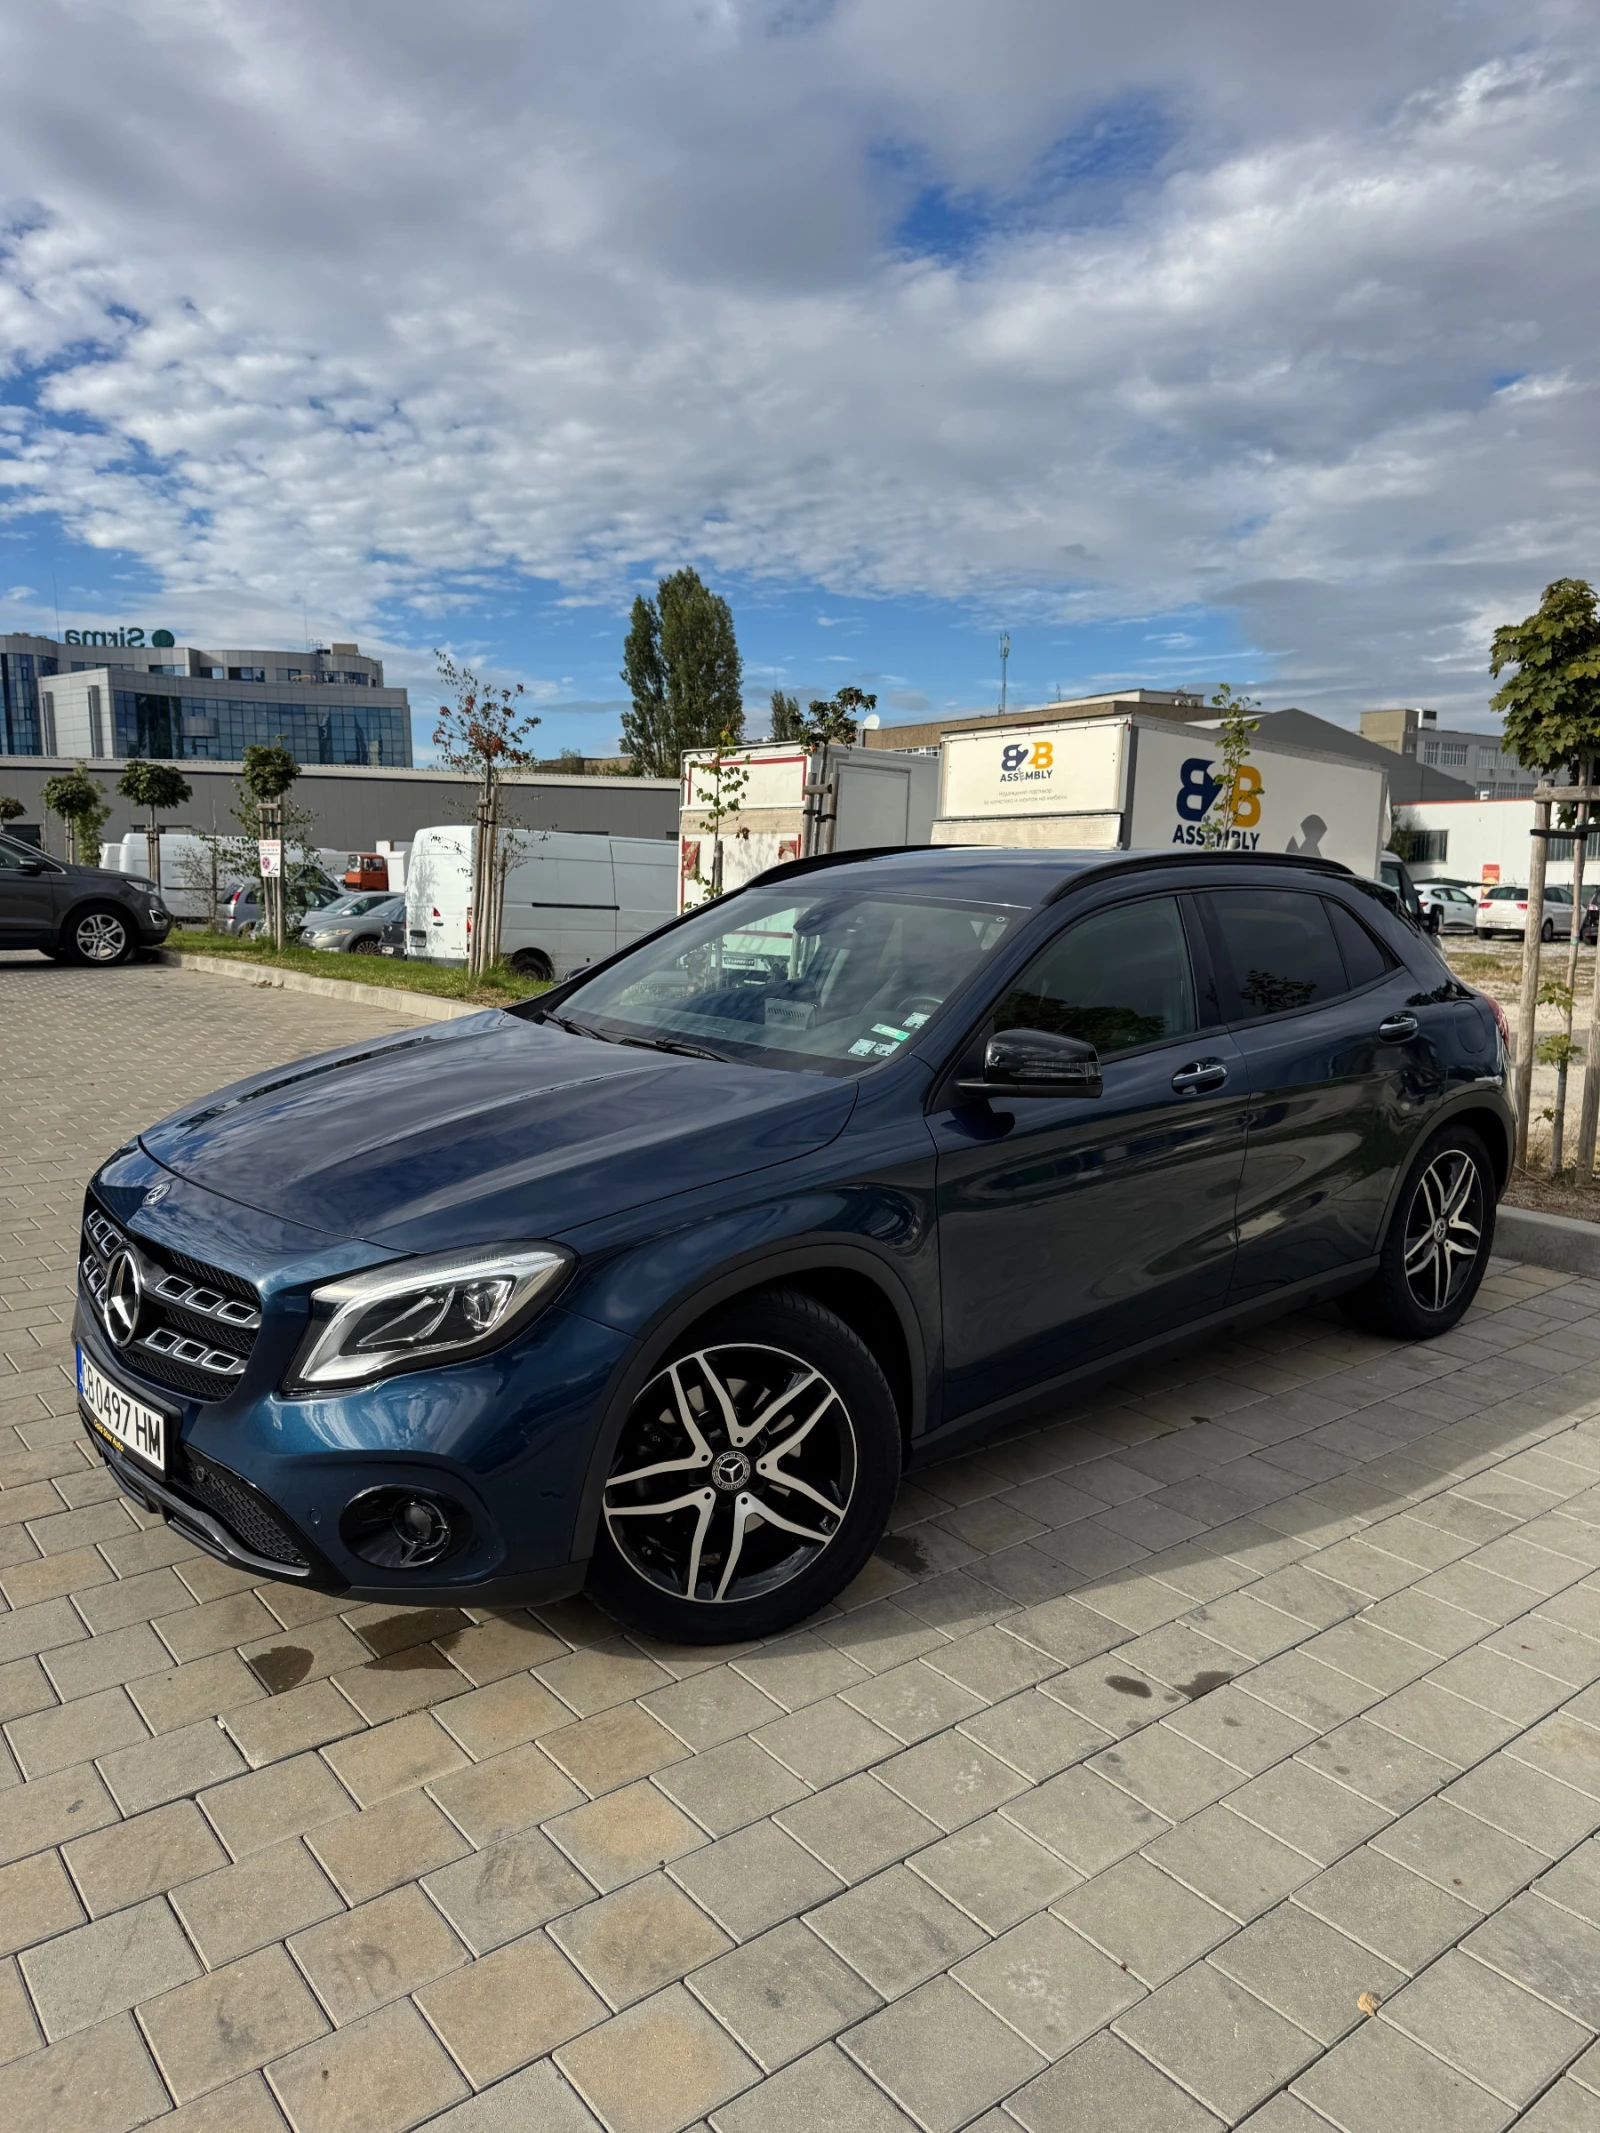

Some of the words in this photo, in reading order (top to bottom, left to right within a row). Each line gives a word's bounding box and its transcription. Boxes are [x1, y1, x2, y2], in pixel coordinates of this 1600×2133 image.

[1000, 769, 1053, 783] ASSEMBLY
[1172, 820, 1260, 850] ASSEMBLY
[83, 1357, 95, 1404] CB
[95, 1376, 131, 1436] 0497
[135, 1406, 161, 1462] HM
